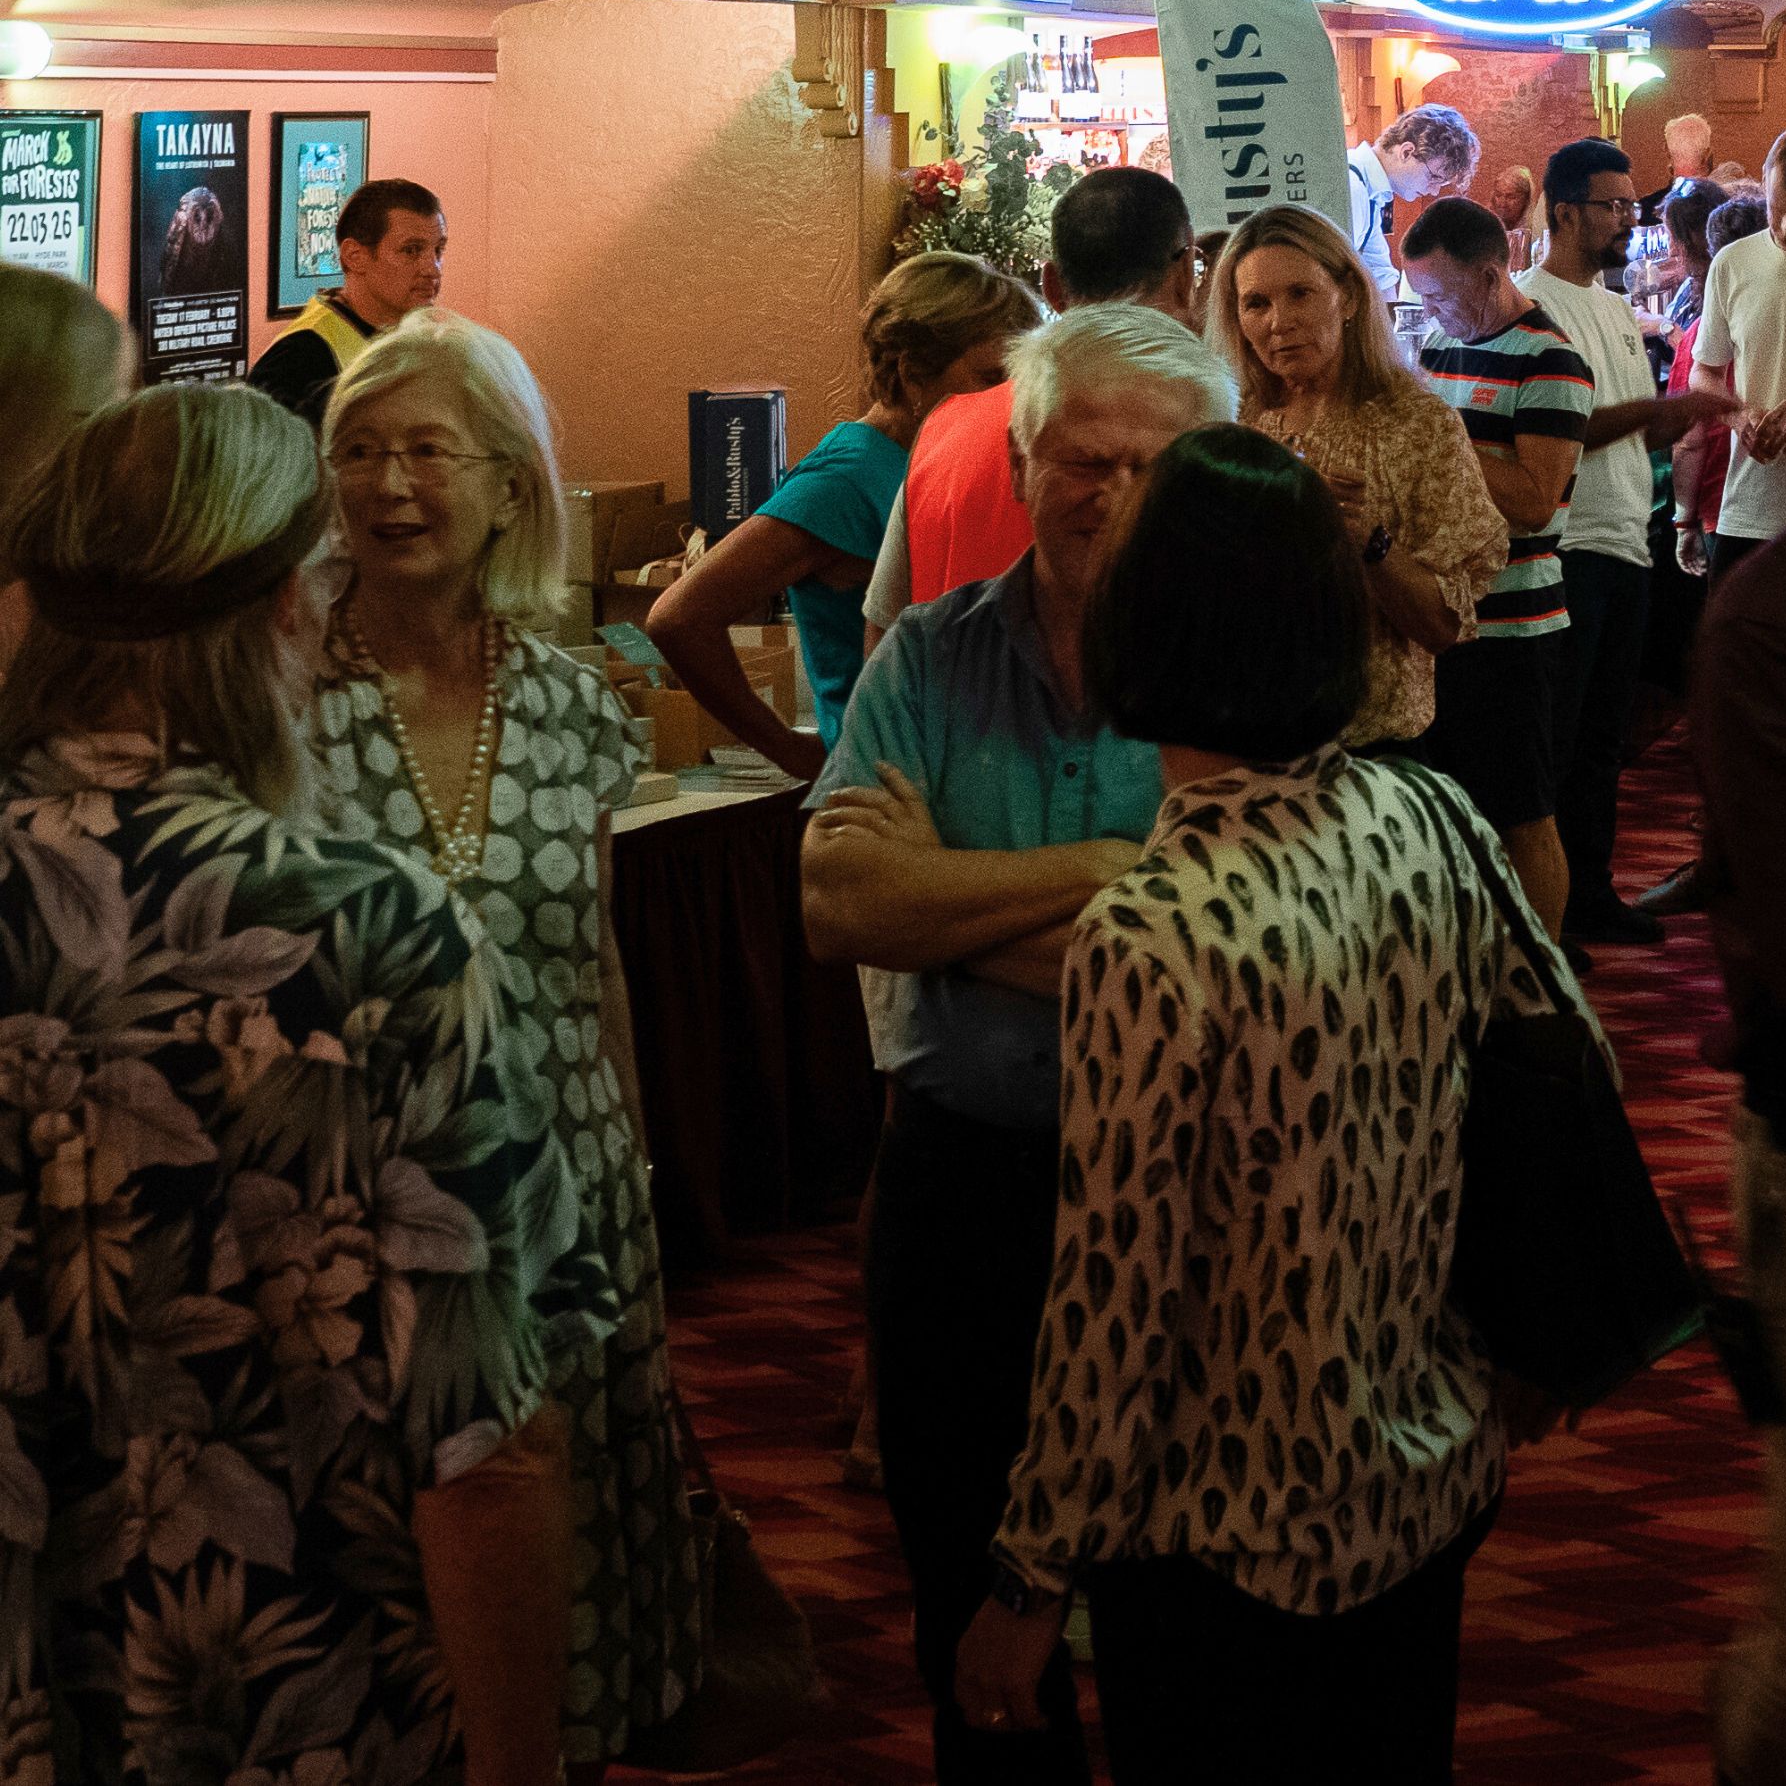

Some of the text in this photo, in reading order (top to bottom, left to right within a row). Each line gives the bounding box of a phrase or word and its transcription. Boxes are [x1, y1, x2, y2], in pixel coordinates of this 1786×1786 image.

[156, 122, 235, 157] TAKAYNA
[1195, 23, 1289, 225] usty's
[2, 130, 51, 171] MARCH
[2, 164, 80, 200] FOR FORESTS
